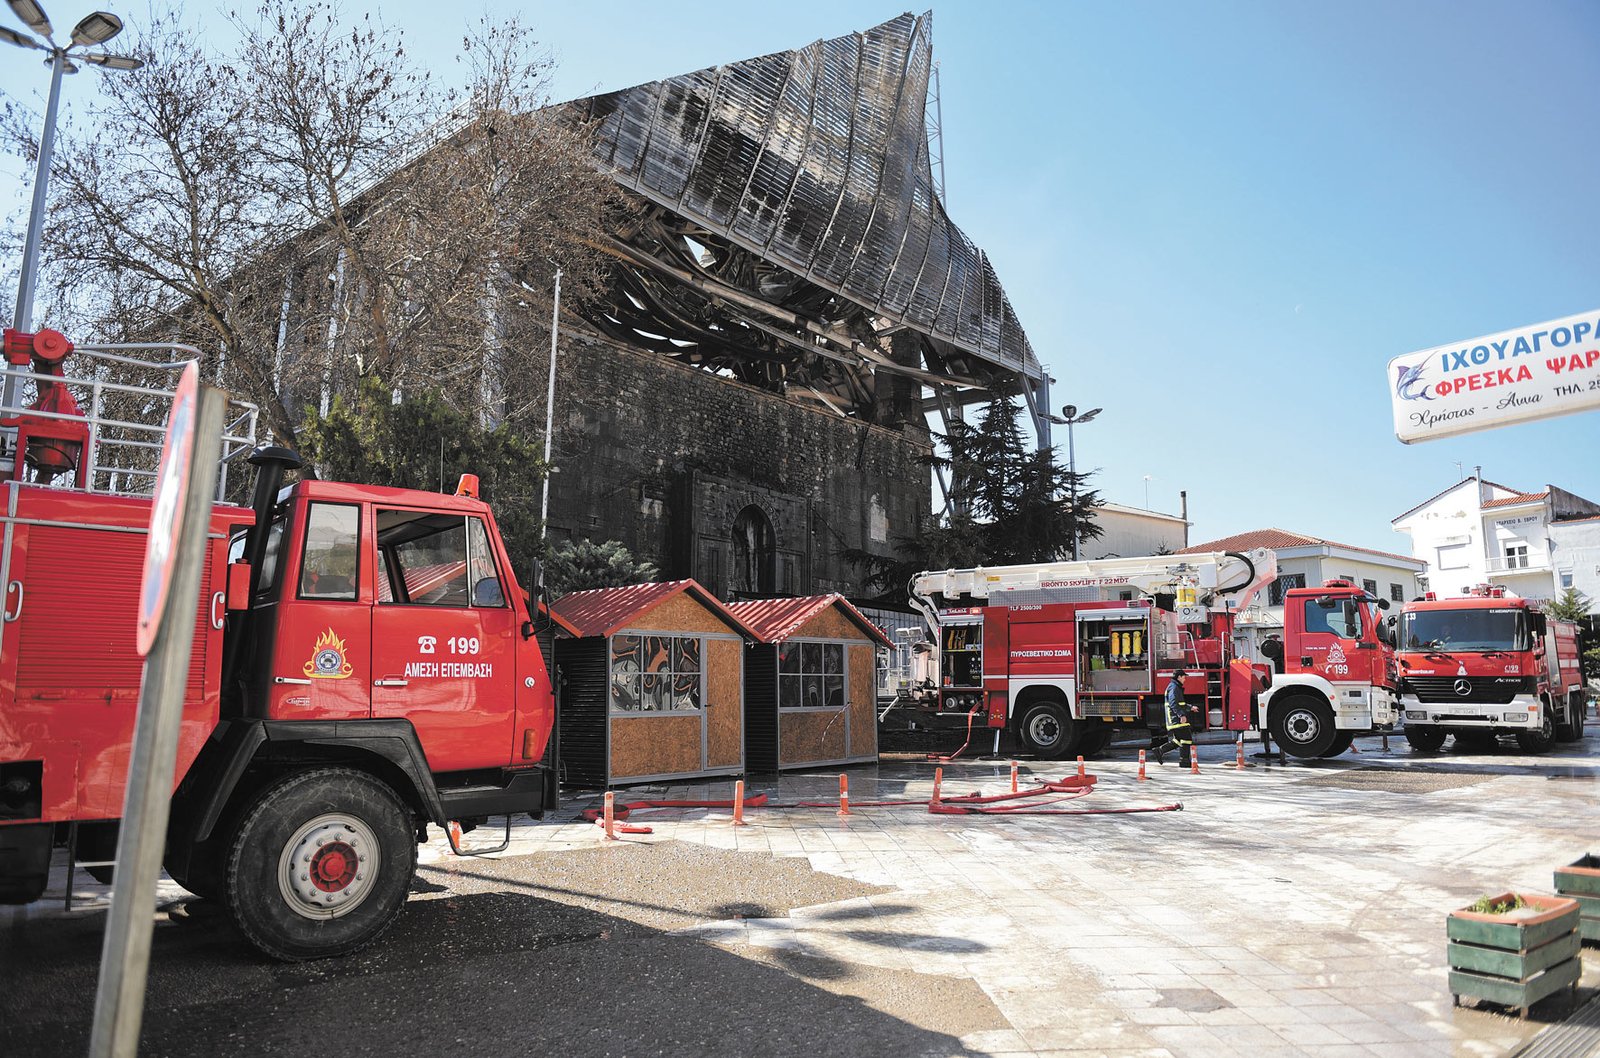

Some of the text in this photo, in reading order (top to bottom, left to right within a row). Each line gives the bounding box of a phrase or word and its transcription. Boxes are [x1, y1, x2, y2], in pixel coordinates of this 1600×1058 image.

[1435, 365, 1533, 397] ΦΡΕΣΚΑ
[1409, 405, 1475, 429] Χρήστος
[1553, 382, 1585, 398] ΤΗΛ.
[1041, 580, 1068, 588] BRONTO
[1069, 579, 1096, 587] SKYLIFT
[447, 637, 479, 655] 199
[1010, 649, 1072, 658] ΠΥΡΟΣΒΕΣΤΙΚΟ ΣΩΜΑ
[404, 662, 493, 678] ΑΜΕΣΗ ΕΠΕΜΒΑΣΗ
[1334, 664, 1349, 675] 199
